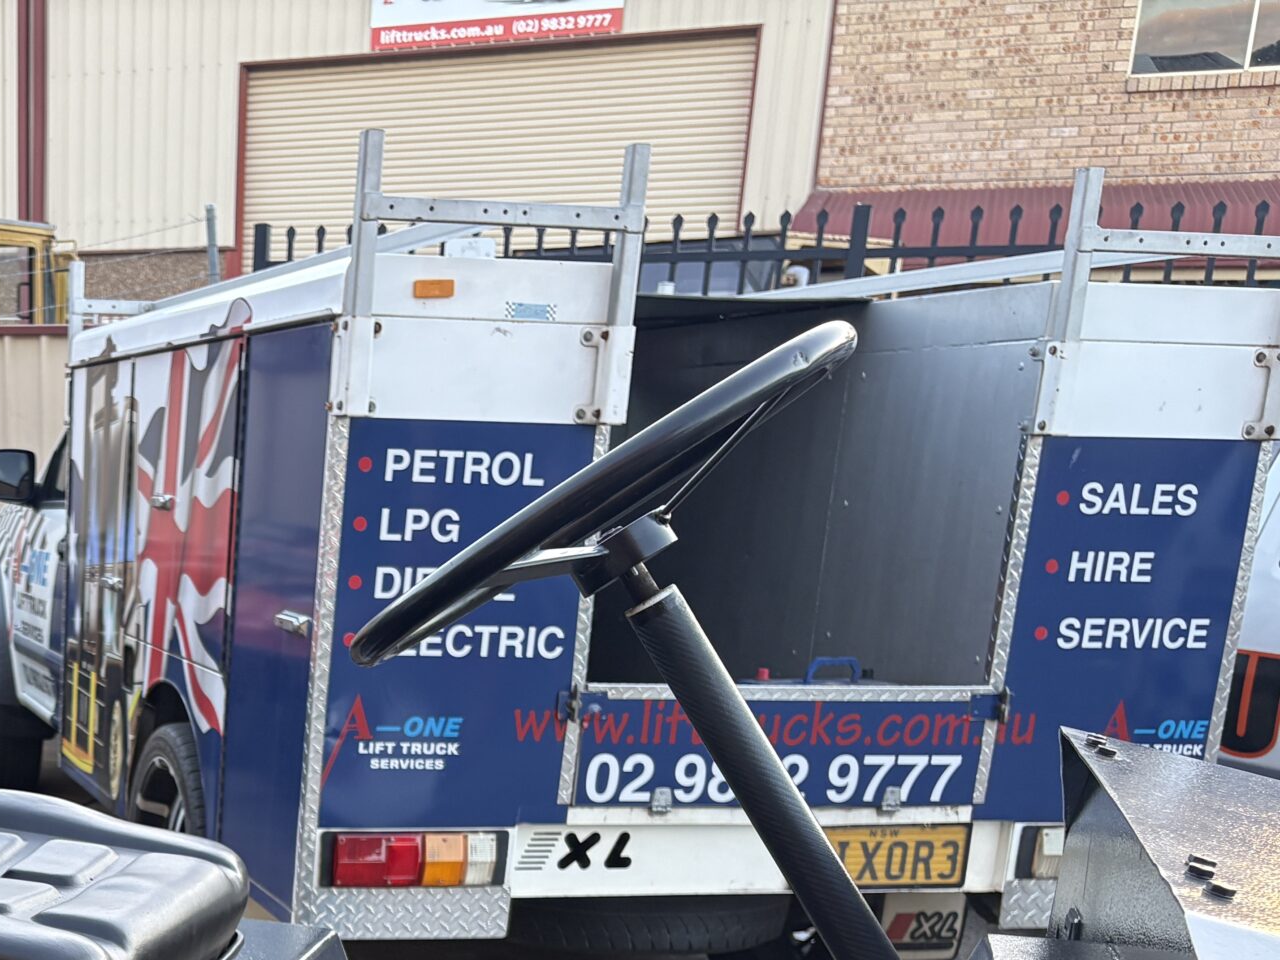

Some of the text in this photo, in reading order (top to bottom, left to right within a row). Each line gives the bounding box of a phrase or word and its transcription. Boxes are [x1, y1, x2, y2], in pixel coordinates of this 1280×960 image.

[380, 23, 504, 44] lifttrucks.com.au
[512, 18, 539, 35] (02)
[577, 13, 612, 28] 9777
[384, 448, 545, 487] PETROL
[1078, 481, 1199, 516] SALES
[379, 508, 461, 543] LPG
[1068, 551, 1155, 583] HIRE
[384, 624, 565, 659] ECTRIC
[1056, 617, 1211, 650] SERVICE
[358, 742, 461, 755] LIFT TRUCK
[370, 758, 445, 770] SERVICES
[585, 752, 963, 804] 02 982 9777
[557, 832, 632, 869] XL
[910, 911, 958, 939] XL
